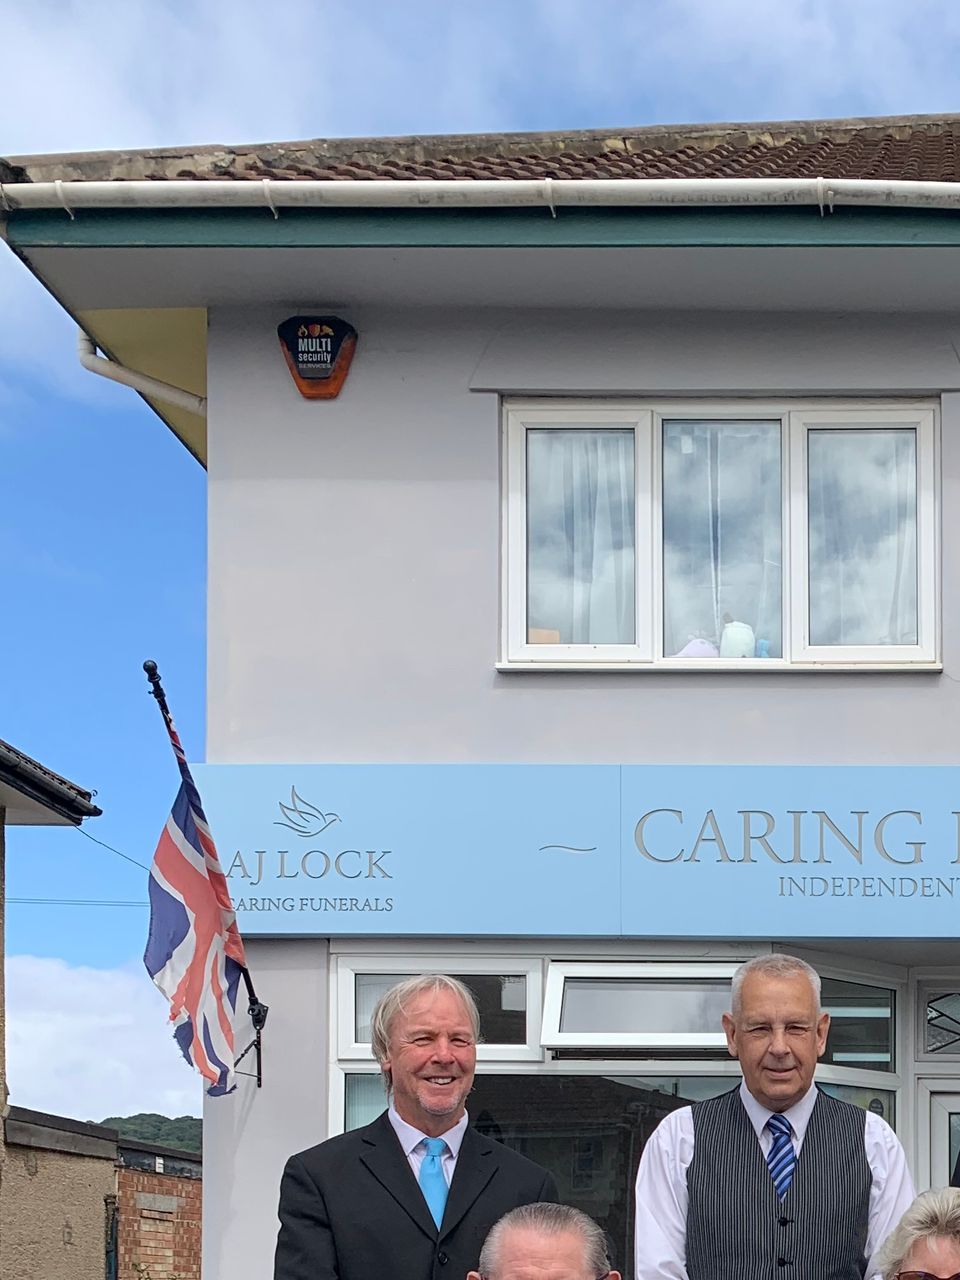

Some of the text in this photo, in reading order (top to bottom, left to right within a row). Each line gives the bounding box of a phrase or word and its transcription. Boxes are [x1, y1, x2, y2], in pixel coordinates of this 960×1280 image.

[298, 338, 331, 351] MULTI
[298, 351, 331, 363] security
[634, 808, 928, 865] CARING
[225, 850, 393, 886] AJ LOCK
[299, 897, 394, 912] FUNERALS
